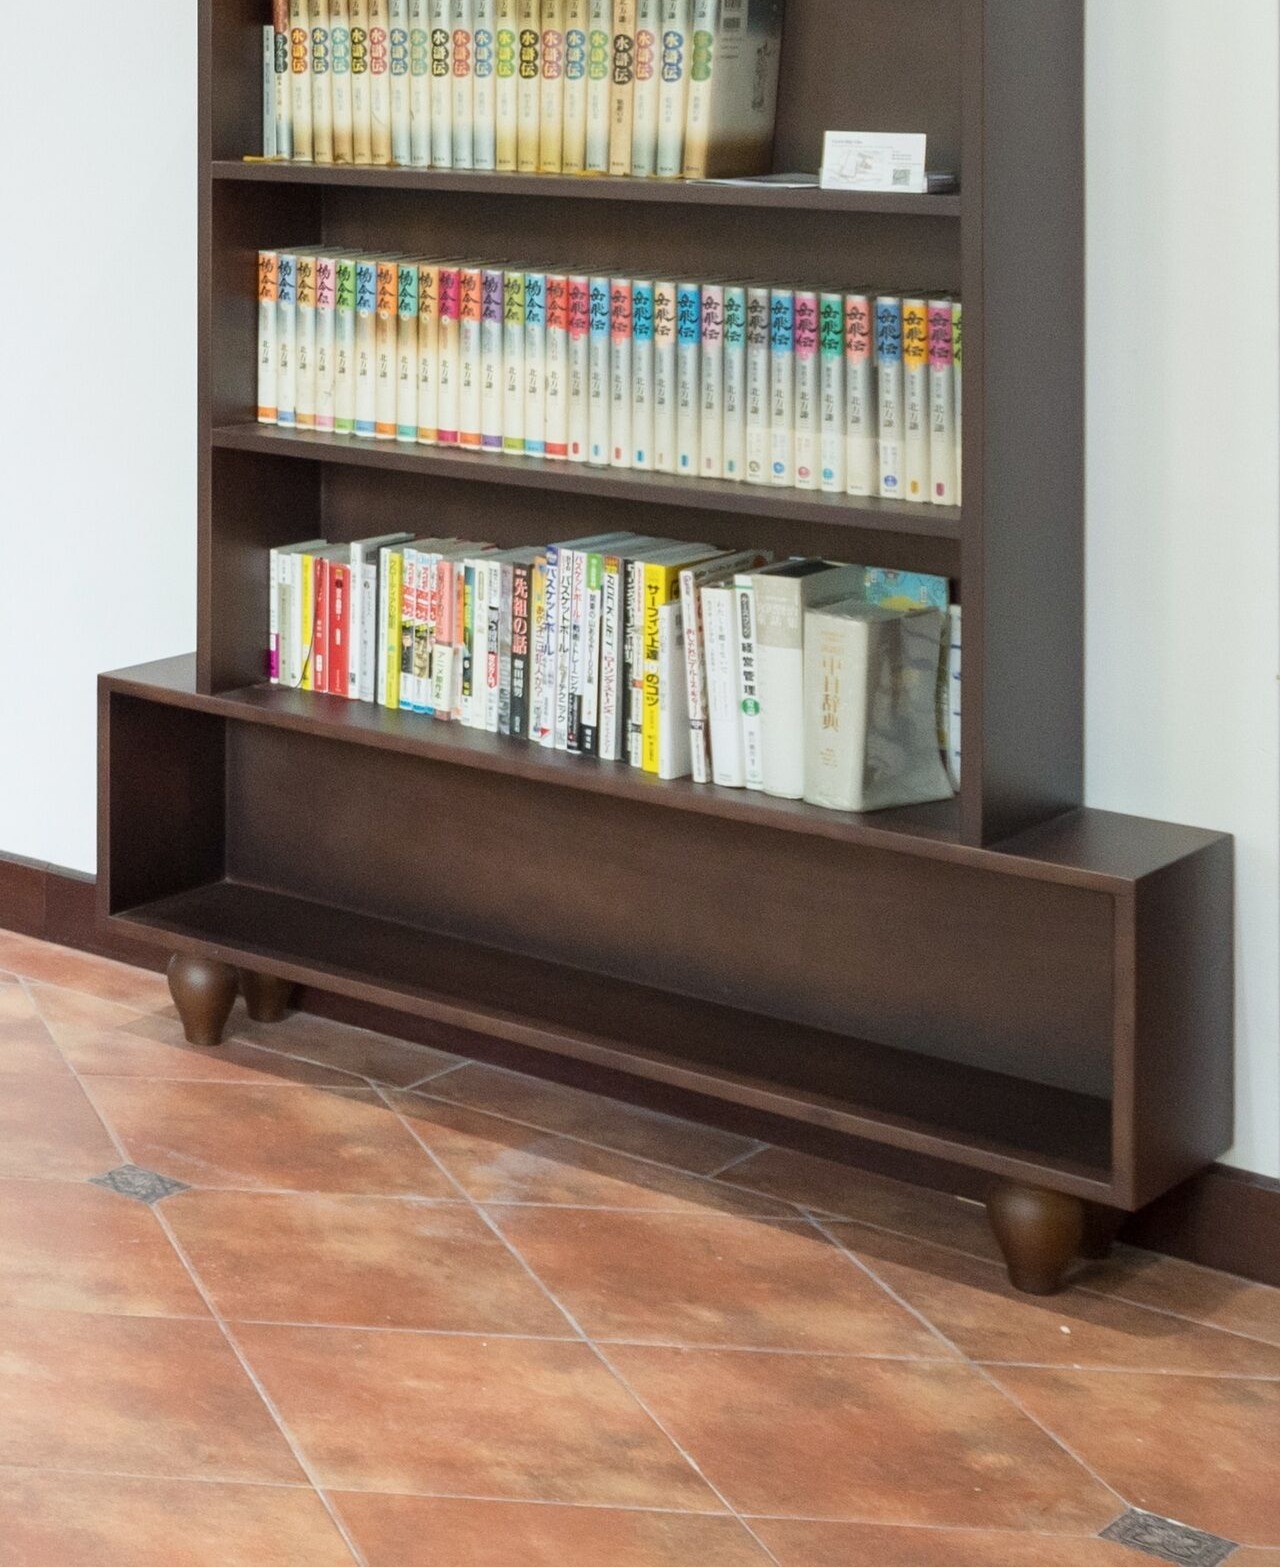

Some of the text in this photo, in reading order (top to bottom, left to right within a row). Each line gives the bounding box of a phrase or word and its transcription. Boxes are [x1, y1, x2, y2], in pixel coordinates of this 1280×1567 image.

[613, 34, 632, 84] 水滸伝
[512, 577, 528, 655] 先祖の話
[542, 566, 556, 656] バスケットボール
[558, 575, 571, 654] バスケットボール
[646, 584, 660, 661] サーフィン上達
[645, 673, 660, 707] のコツ
[741, 642, 756, 696] 経営管理
